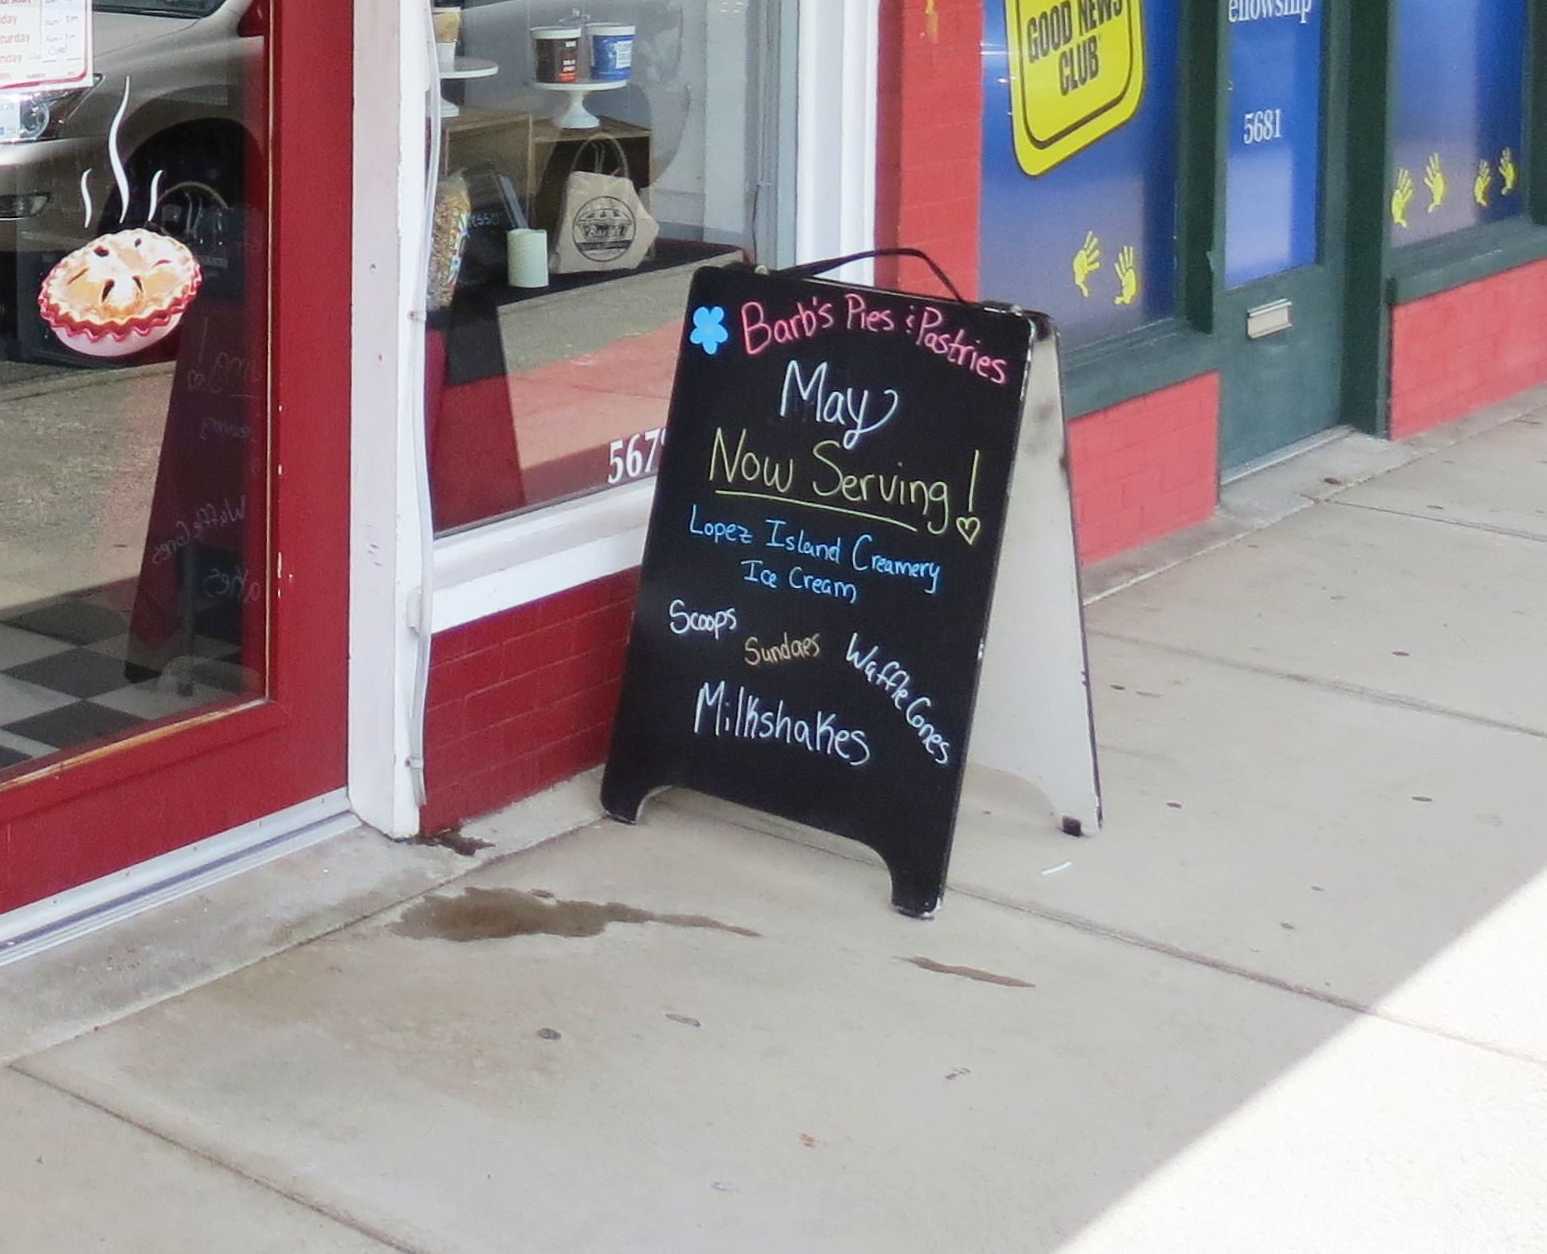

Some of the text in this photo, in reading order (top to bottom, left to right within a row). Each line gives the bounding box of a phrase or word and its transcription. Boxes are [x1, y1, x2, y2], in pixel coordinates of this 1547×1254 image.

[1027, 0, 1073, 64] GOOD
[1058, 35, 1100, 96] CLUB
[1243, 108, 1283, 145] 5681
[740, 296, 835, 355] Barb's
[844, 293, 895, 331] Pies
[915, 305, 1008, 385] Pastries
[779, 358, 899, 450] May
[709, 426, 794, 493] Now
[689, 504, 941, 595] Lopez Island Creamery
[740, 559, 858, 604] Ice Cream
[668, 598, 737, 640] Scoops
[743, 631, 821, 666] Sundaes
[693, 679, 871, 766] Milkshakes
[844, 631, 951, 765] Waffle Cones
